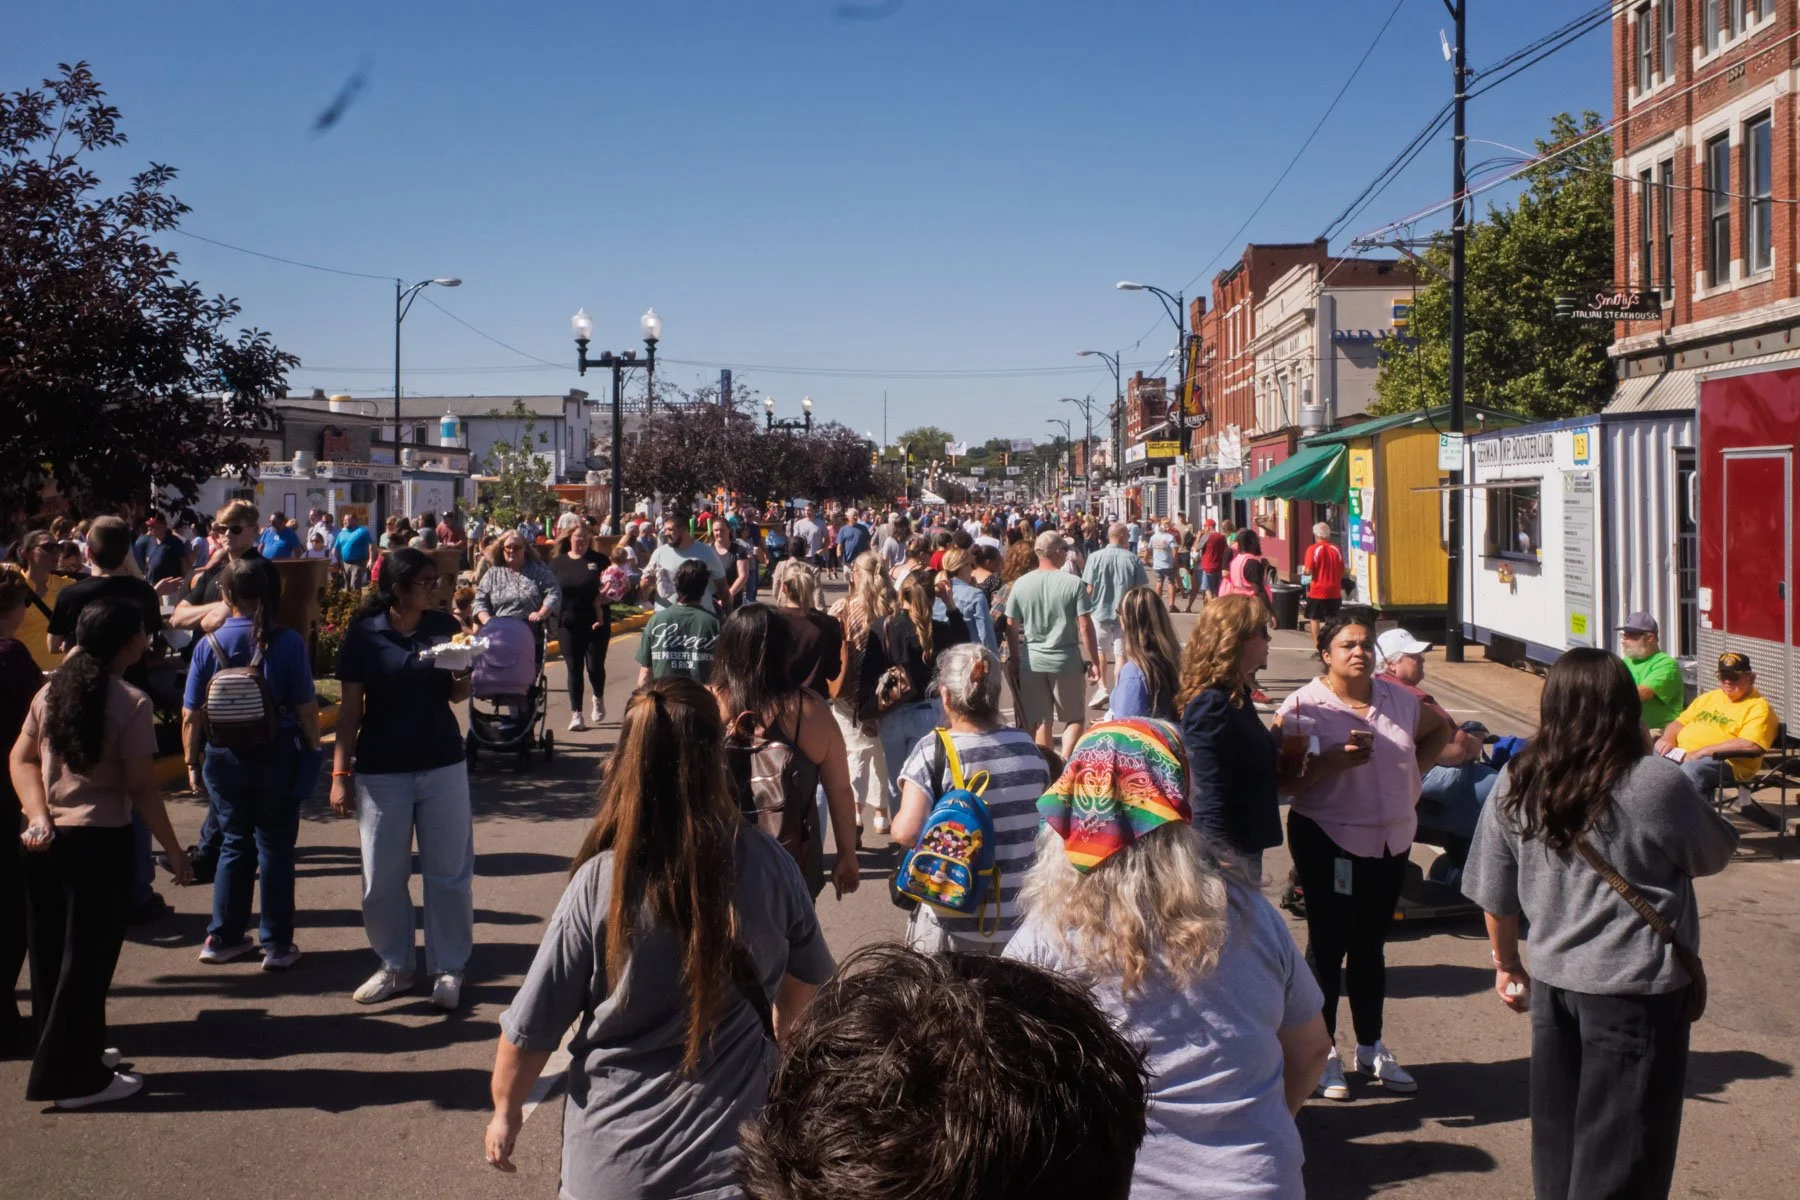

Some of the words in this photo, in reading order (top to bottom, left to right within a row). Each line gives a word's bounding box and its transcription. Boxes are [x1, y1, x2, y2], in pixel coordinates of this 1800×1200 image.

[1571, 310, 1602, 319] ITALIAN
[1604, 311, 1656, 320] STEAKHOUSE
[1331, 329, 1374, 341] OLD
[1477, 441, 1498, 463] GERMAN
[1512, 436, 1538, 460] BOOSTER
[1538, 434, 1553, 458] CLUB
